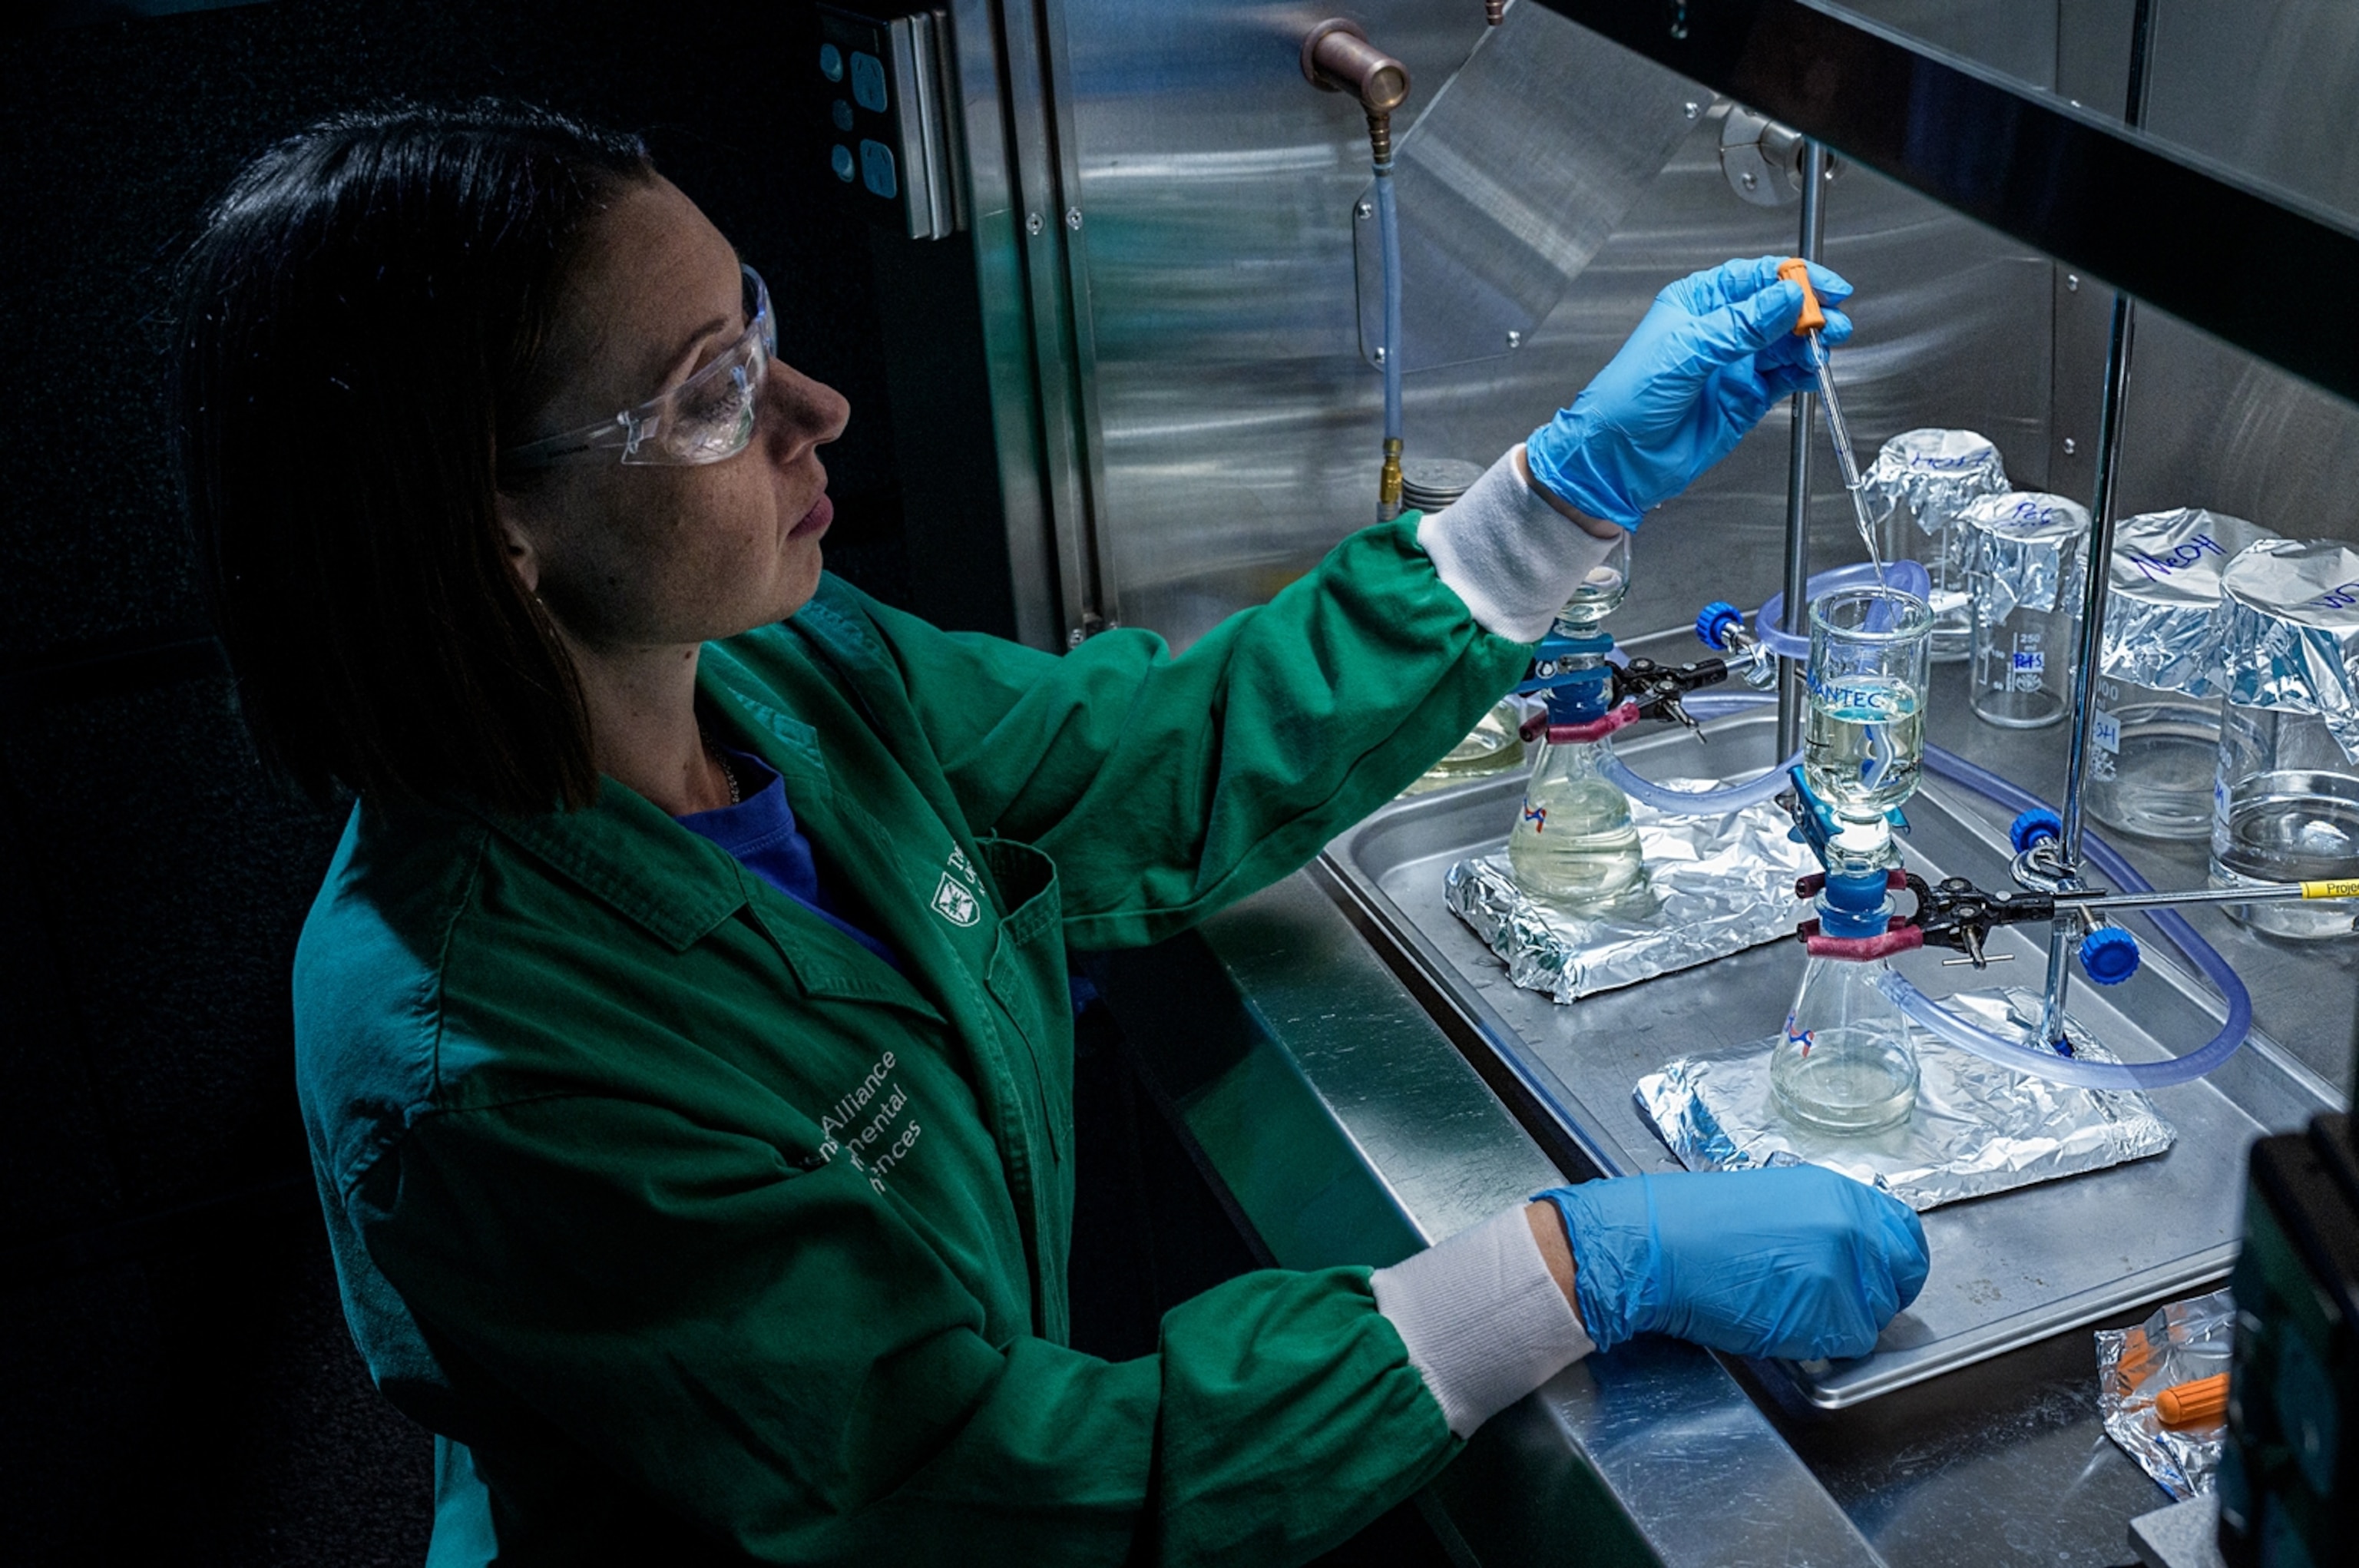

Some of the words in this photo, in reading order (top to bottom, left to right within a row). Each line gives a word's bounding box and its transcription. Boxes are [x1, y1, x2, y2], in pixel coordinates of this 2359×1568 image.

[2129, 534, 2228, 583] MeOH
[2019, 633, 2042, 644] 250
[822, 1050, 897, 1140] Alliance
